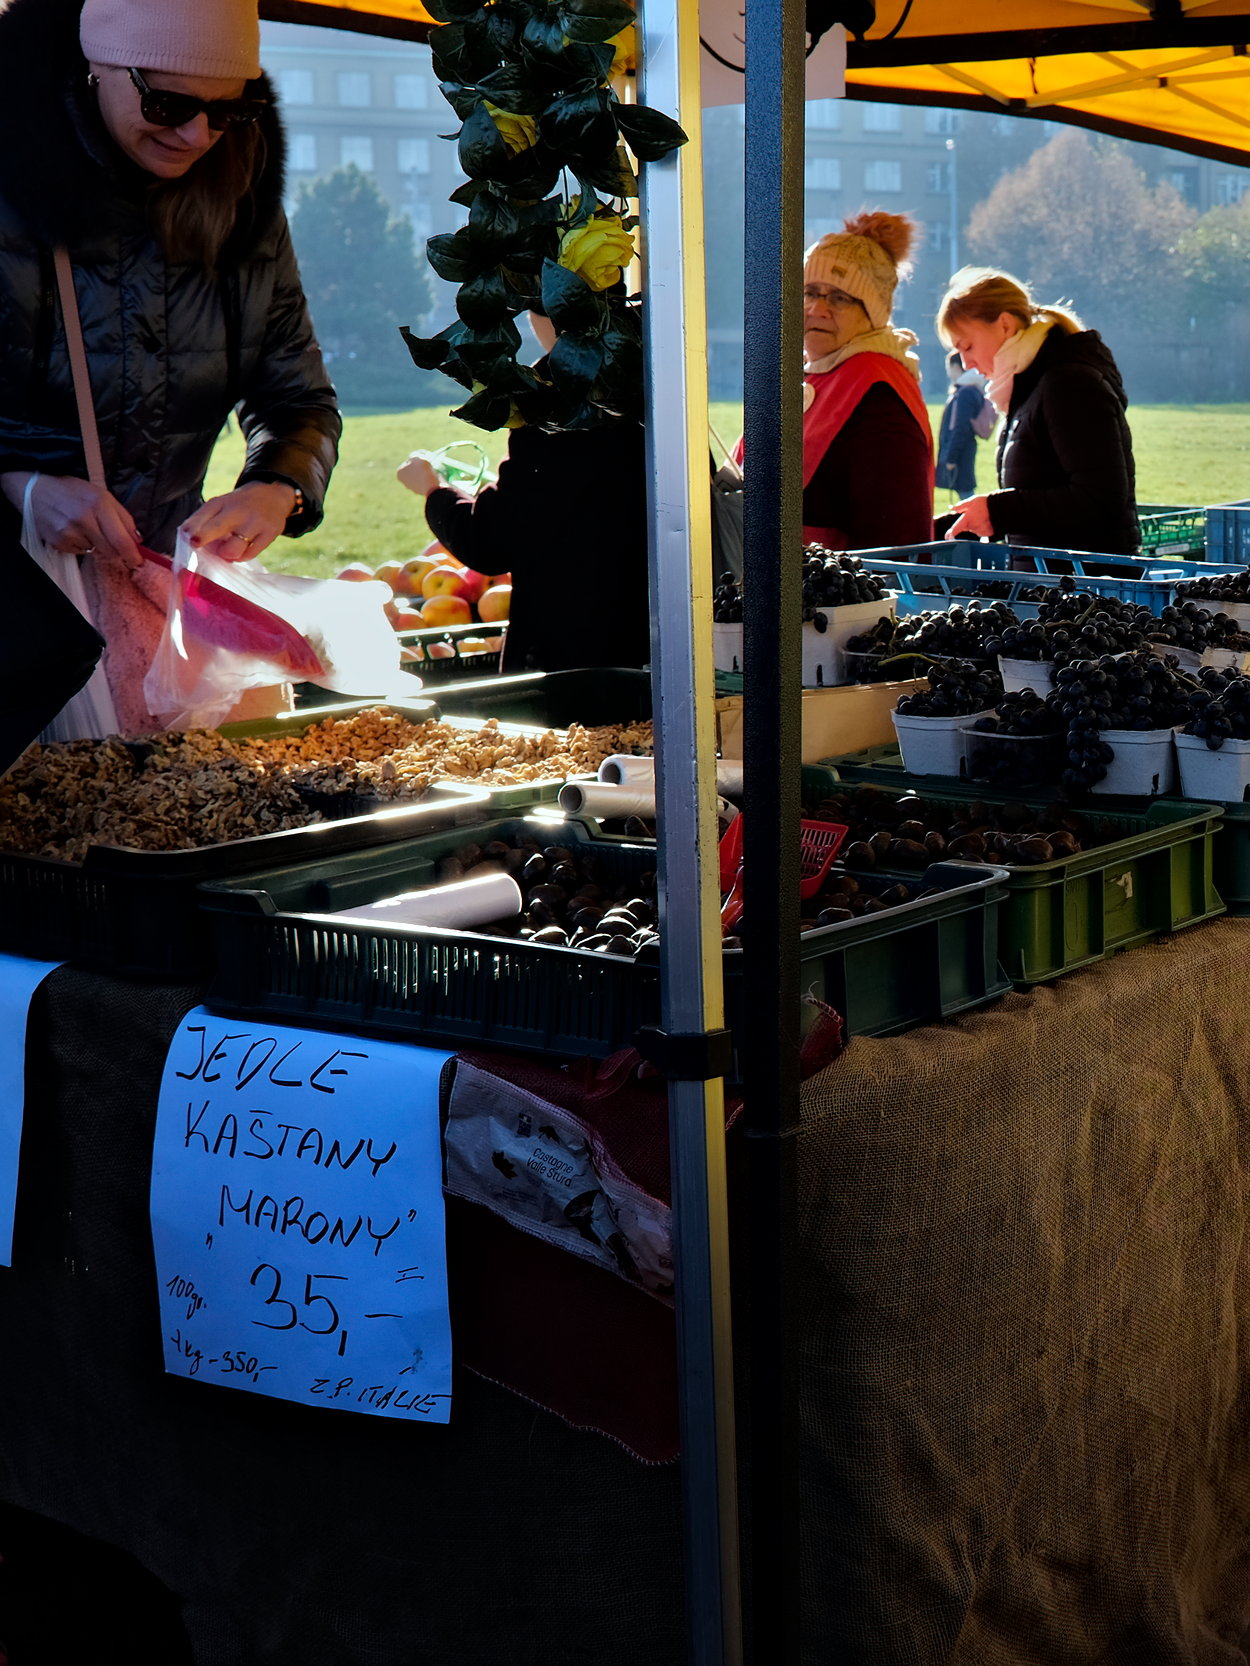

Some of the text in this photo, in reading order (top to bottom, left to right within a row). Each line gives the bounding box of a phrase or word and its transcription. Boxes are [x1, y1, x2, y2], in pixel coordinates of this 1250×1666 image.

[184, 1100, 397, 1177] KAŠTANY
[526, 1157, 572, 1187] Valle Stura
[532, 1147, 574, 1174] Castagne
